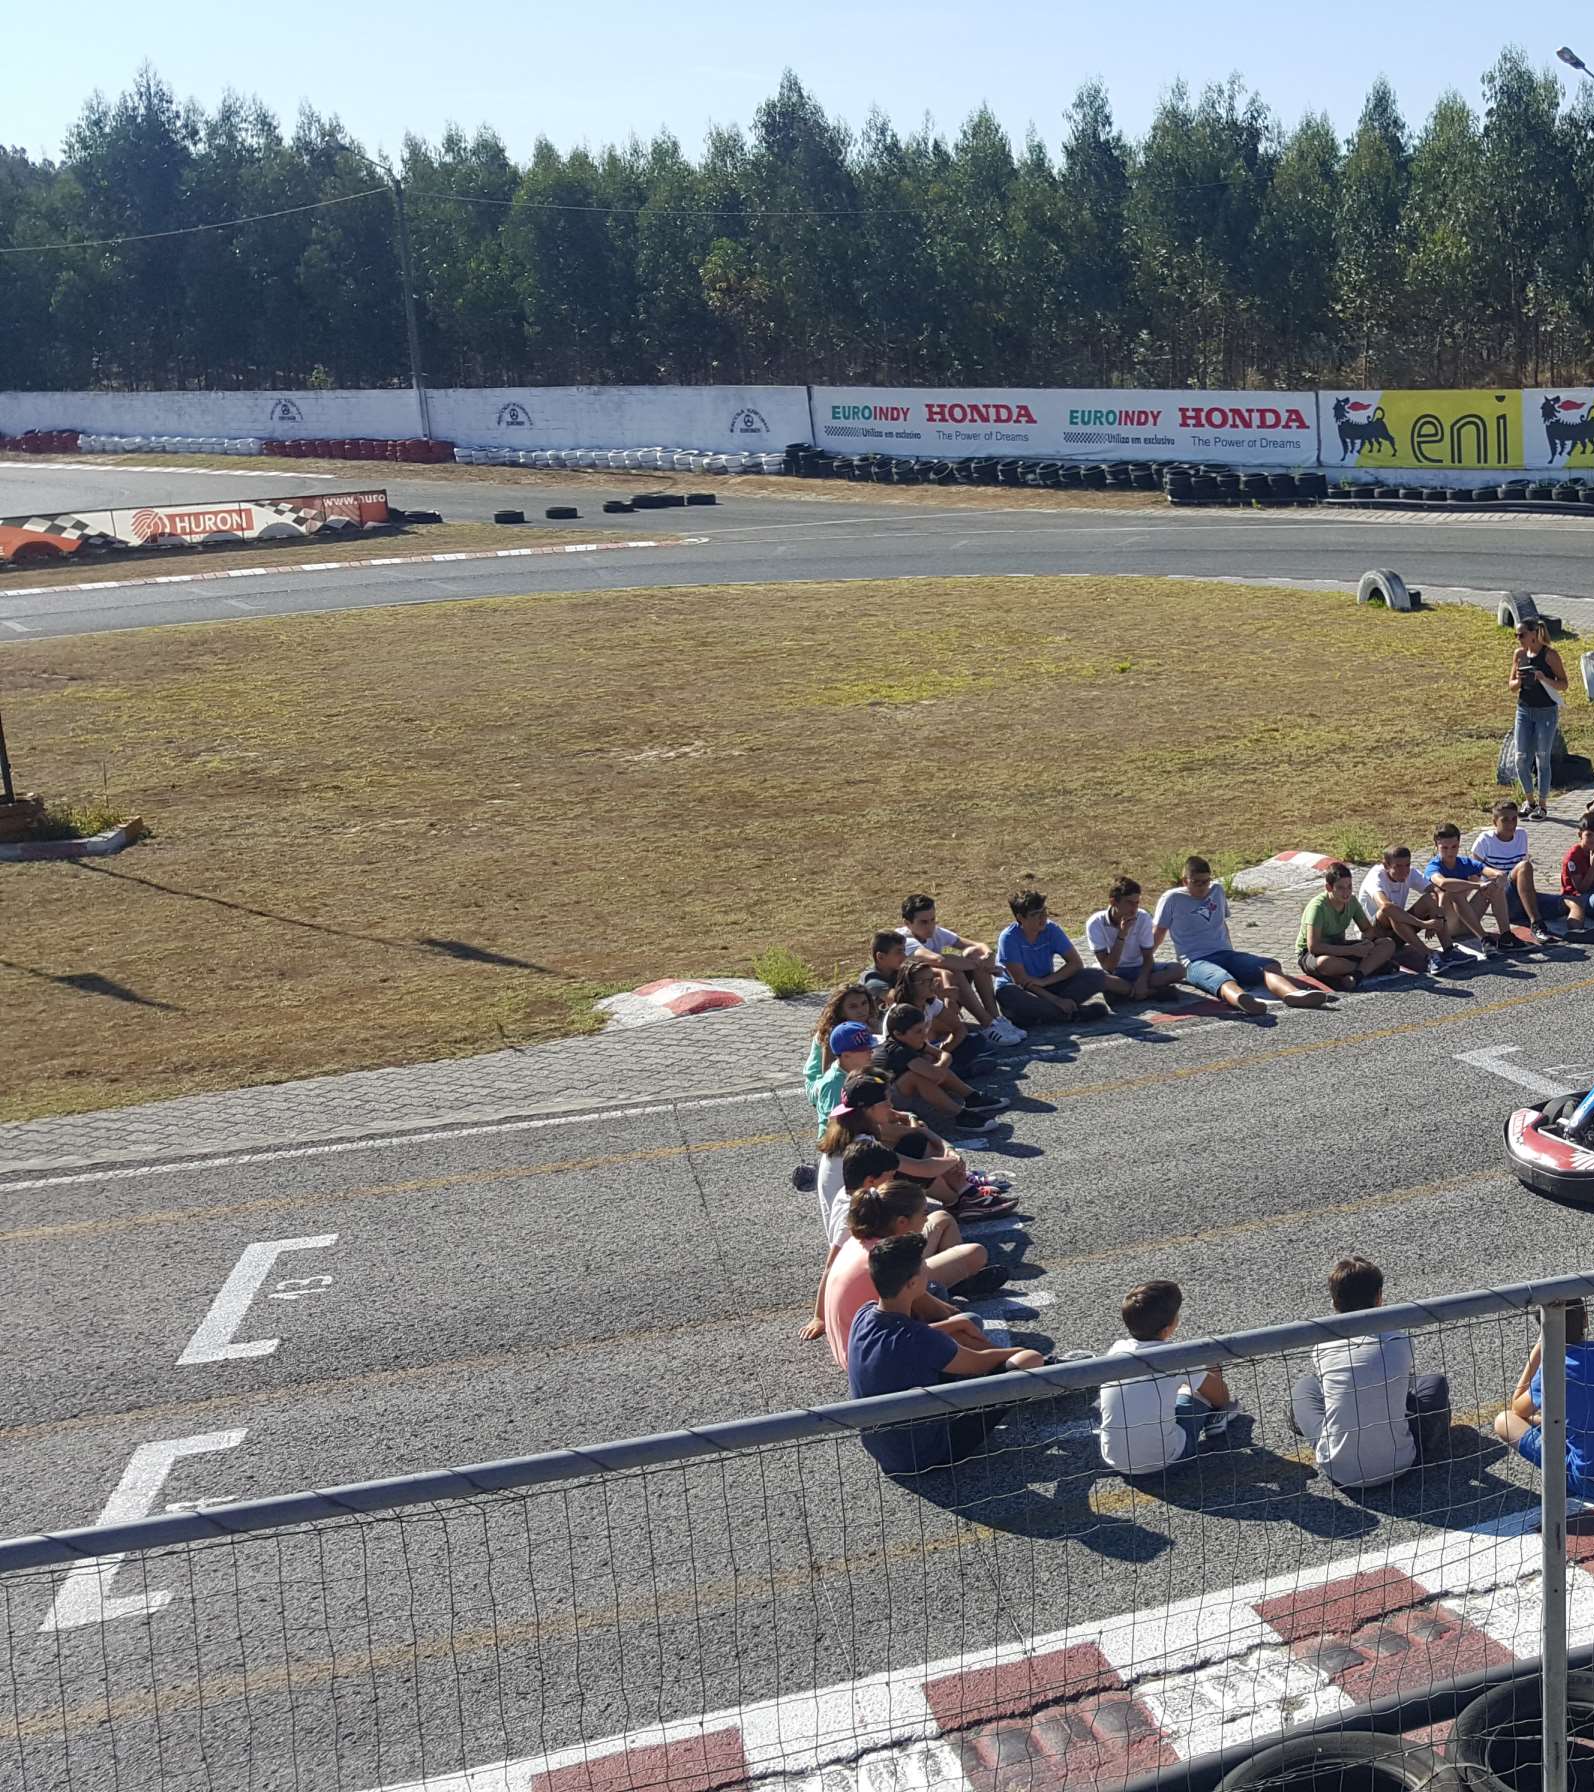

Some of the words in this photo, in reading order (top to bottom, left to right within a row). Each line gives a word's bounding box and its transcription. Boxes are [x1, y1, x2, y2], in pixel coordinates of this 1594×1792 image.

[831, 405, 910, 421] EUROINDY
[924, 403, 1038, 424] HONDA
[1069, 409, 1162, 426] EUROINDY
[1178, 407, 1310, 430] HONDA
[936, 430, 953, 441] The
[955, 431, 981, 441] Power
[984, 431, 993, 441] of
[995, 431, 1030, 442] Dreams
[1410, 395, 1509, 464] eni
[1191, 435, 1211, 447] The
[1214, 436, 1245, 448] Power
[1260, 437, 1301, 449] Dreams
[175, 511, 247, 534] HURON
